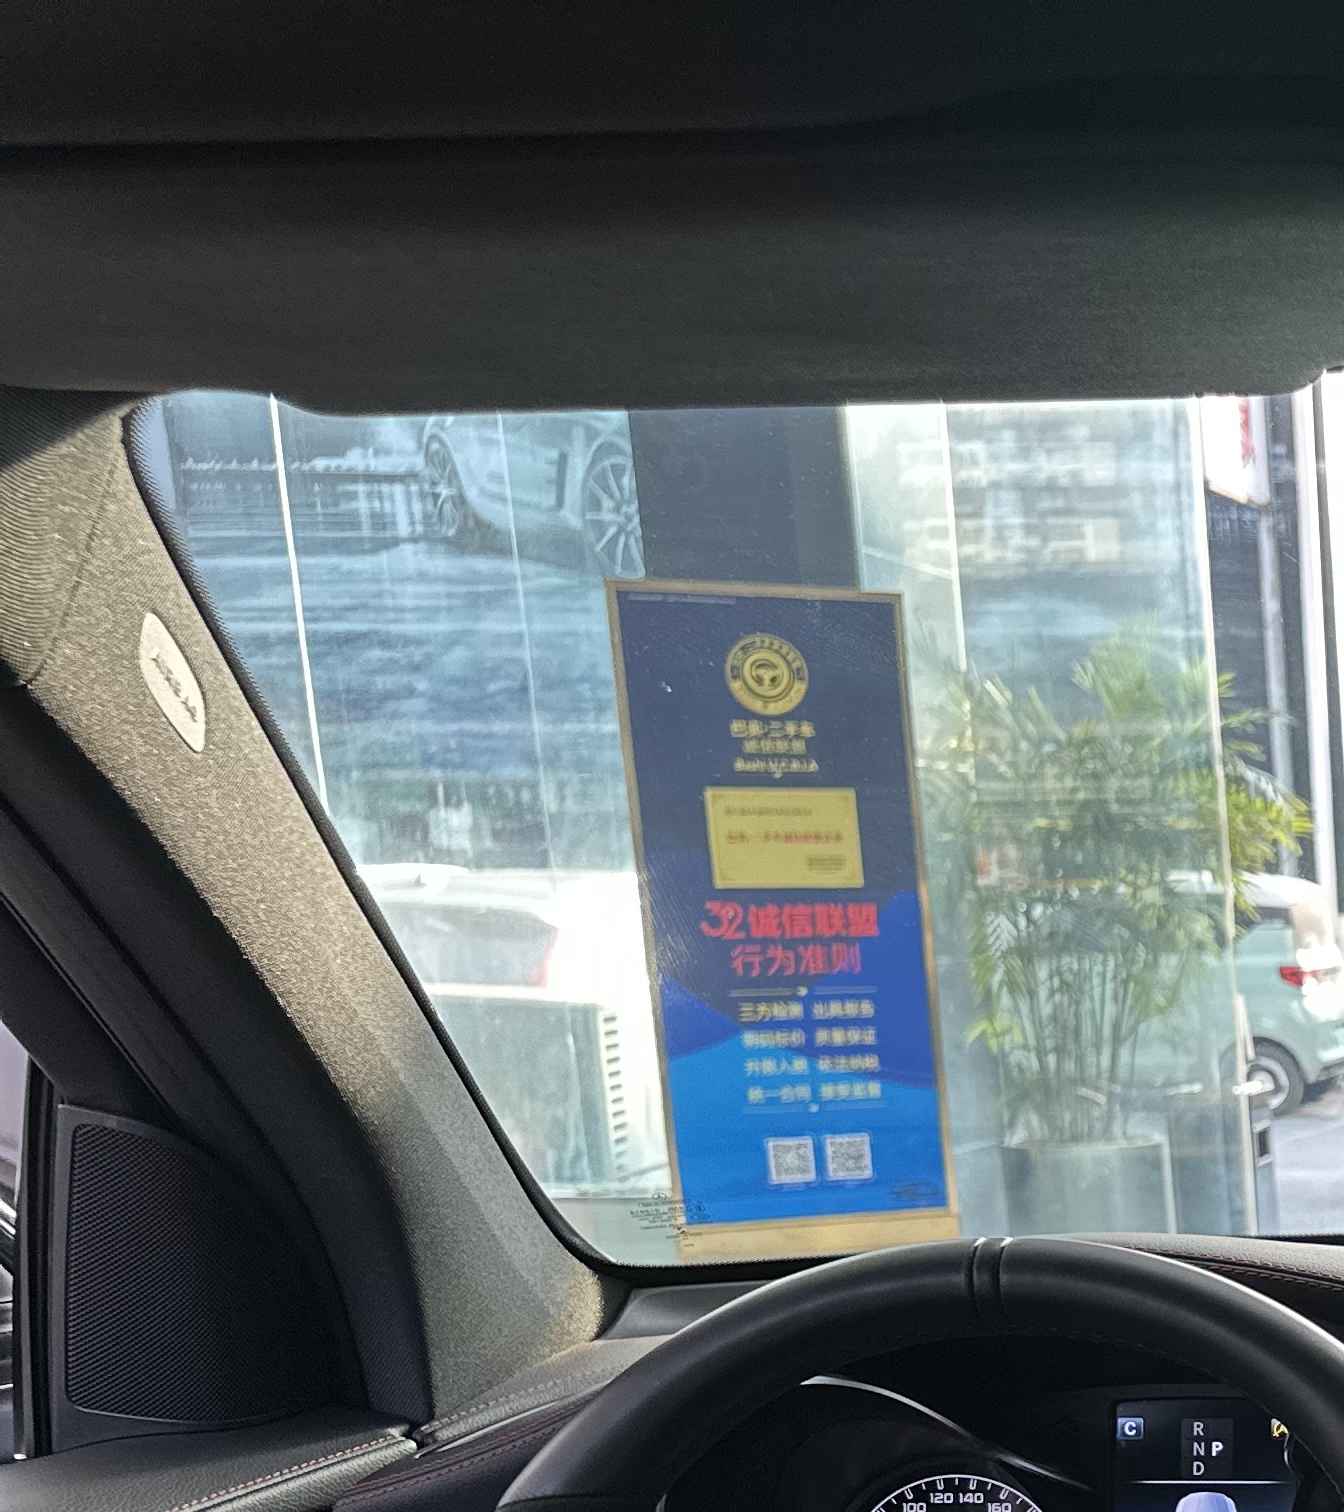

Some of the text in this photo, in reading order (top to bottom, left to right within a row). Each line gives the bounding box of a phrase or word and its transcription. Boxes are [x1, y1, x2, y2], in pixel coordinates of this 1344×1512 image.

[731, 943, 862, 976] 行为准则
[1124, 1421, 1136, 1436] C
[1193, 1421, 1204, 1436] R
[1193, 1441, 1223, 1456] N P
[1193, 1461, 1205, 1476] D
[930, 1493, 954, 1504] 120
[959, 1493, 984, 1504] 140
